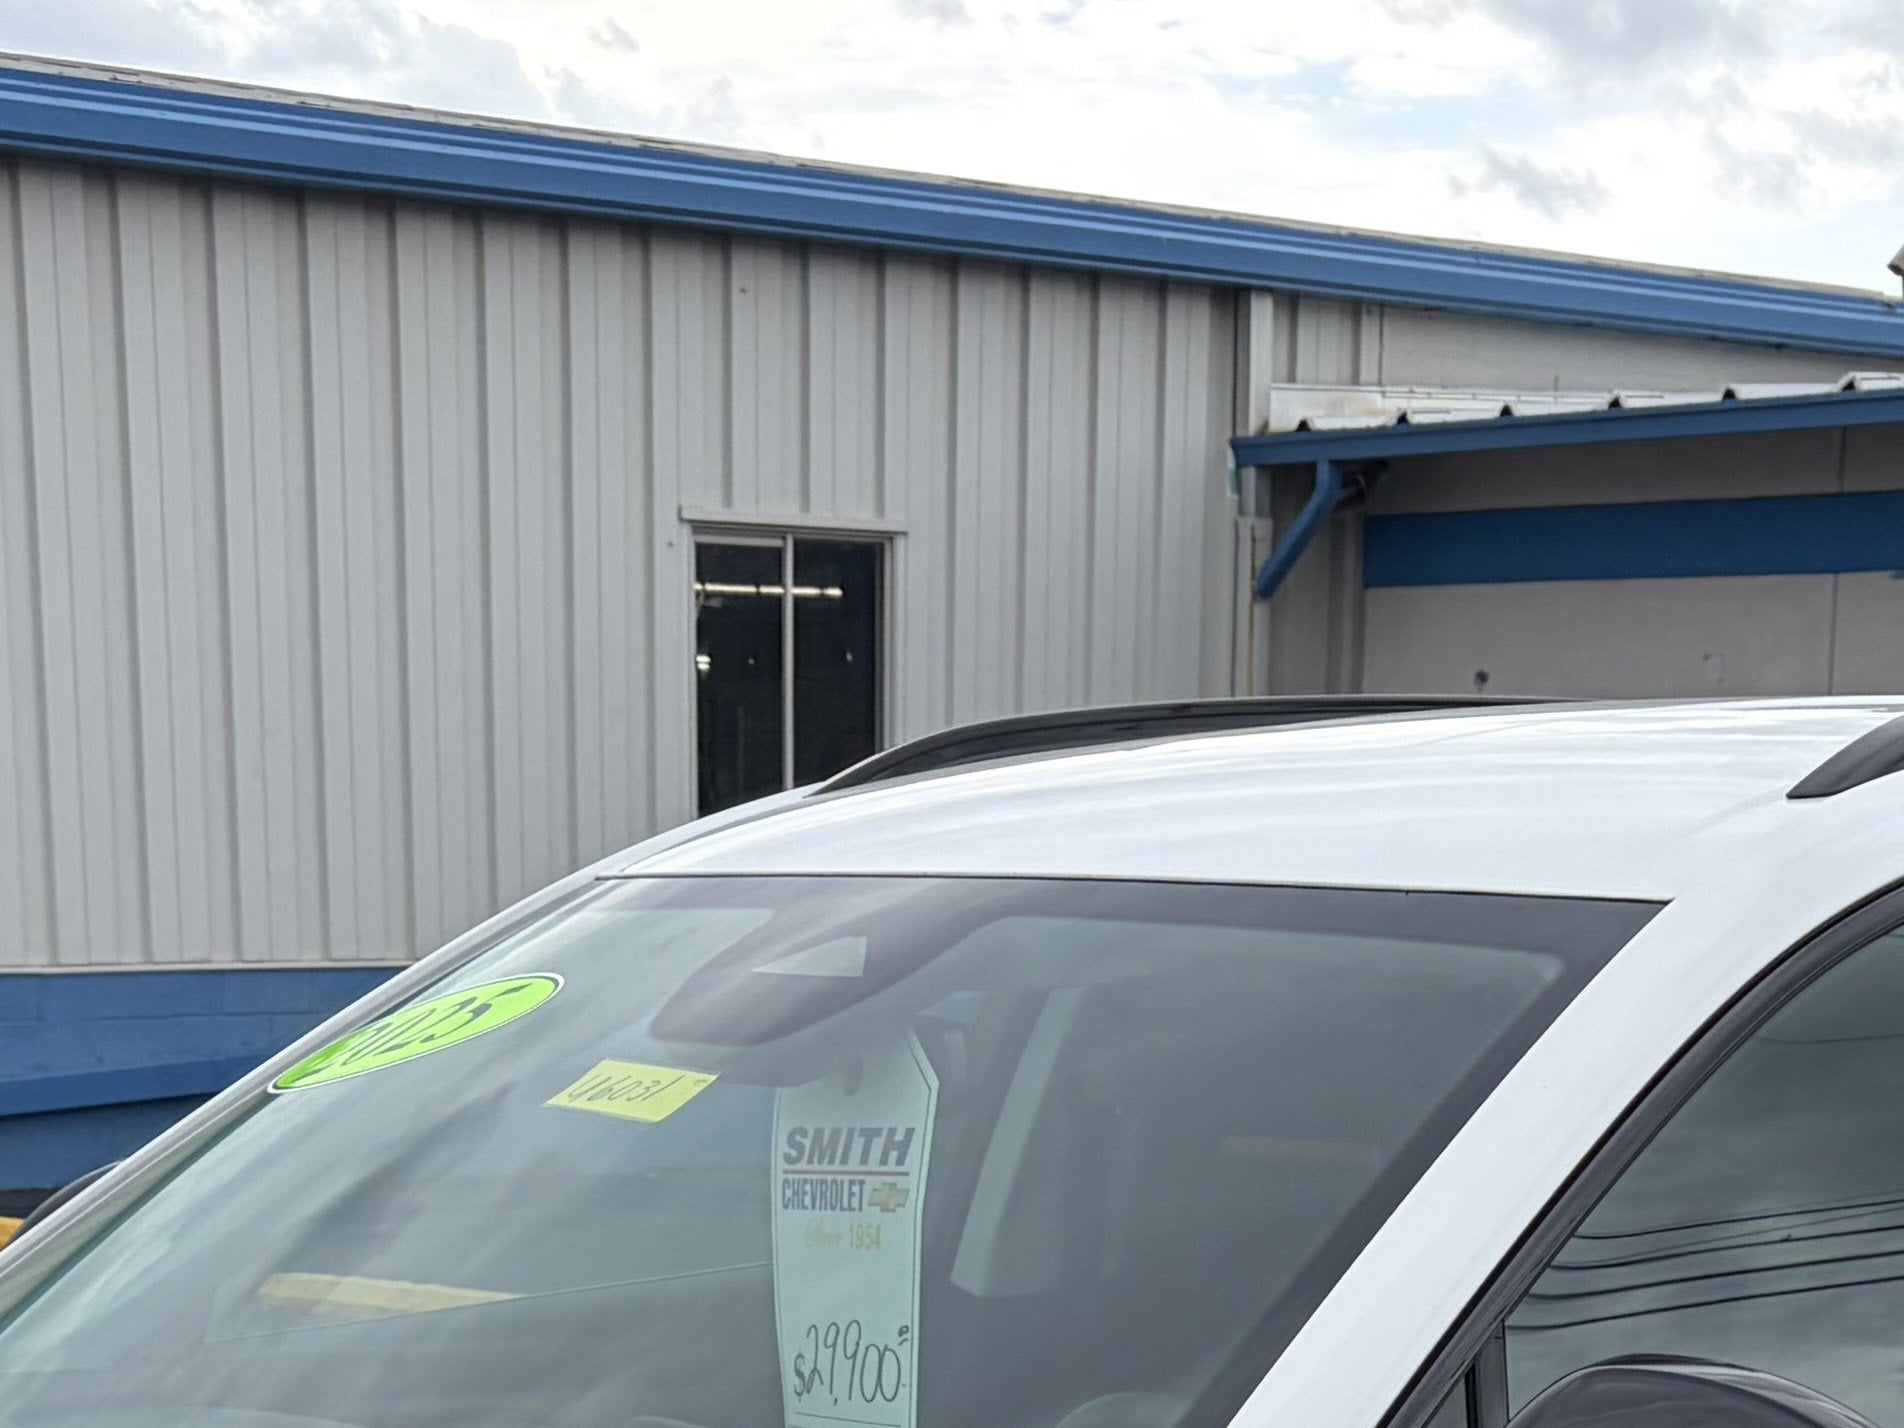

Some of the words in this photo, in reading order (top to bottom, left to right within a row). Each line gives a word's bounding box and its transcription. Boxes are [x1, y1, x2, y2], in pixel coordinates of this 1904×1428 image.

[782, 1126, 916, 1167] SMITH
[781, 1177, 866, 1213] CHEVROLET
[849, 1222, 882, 1250] 1954
